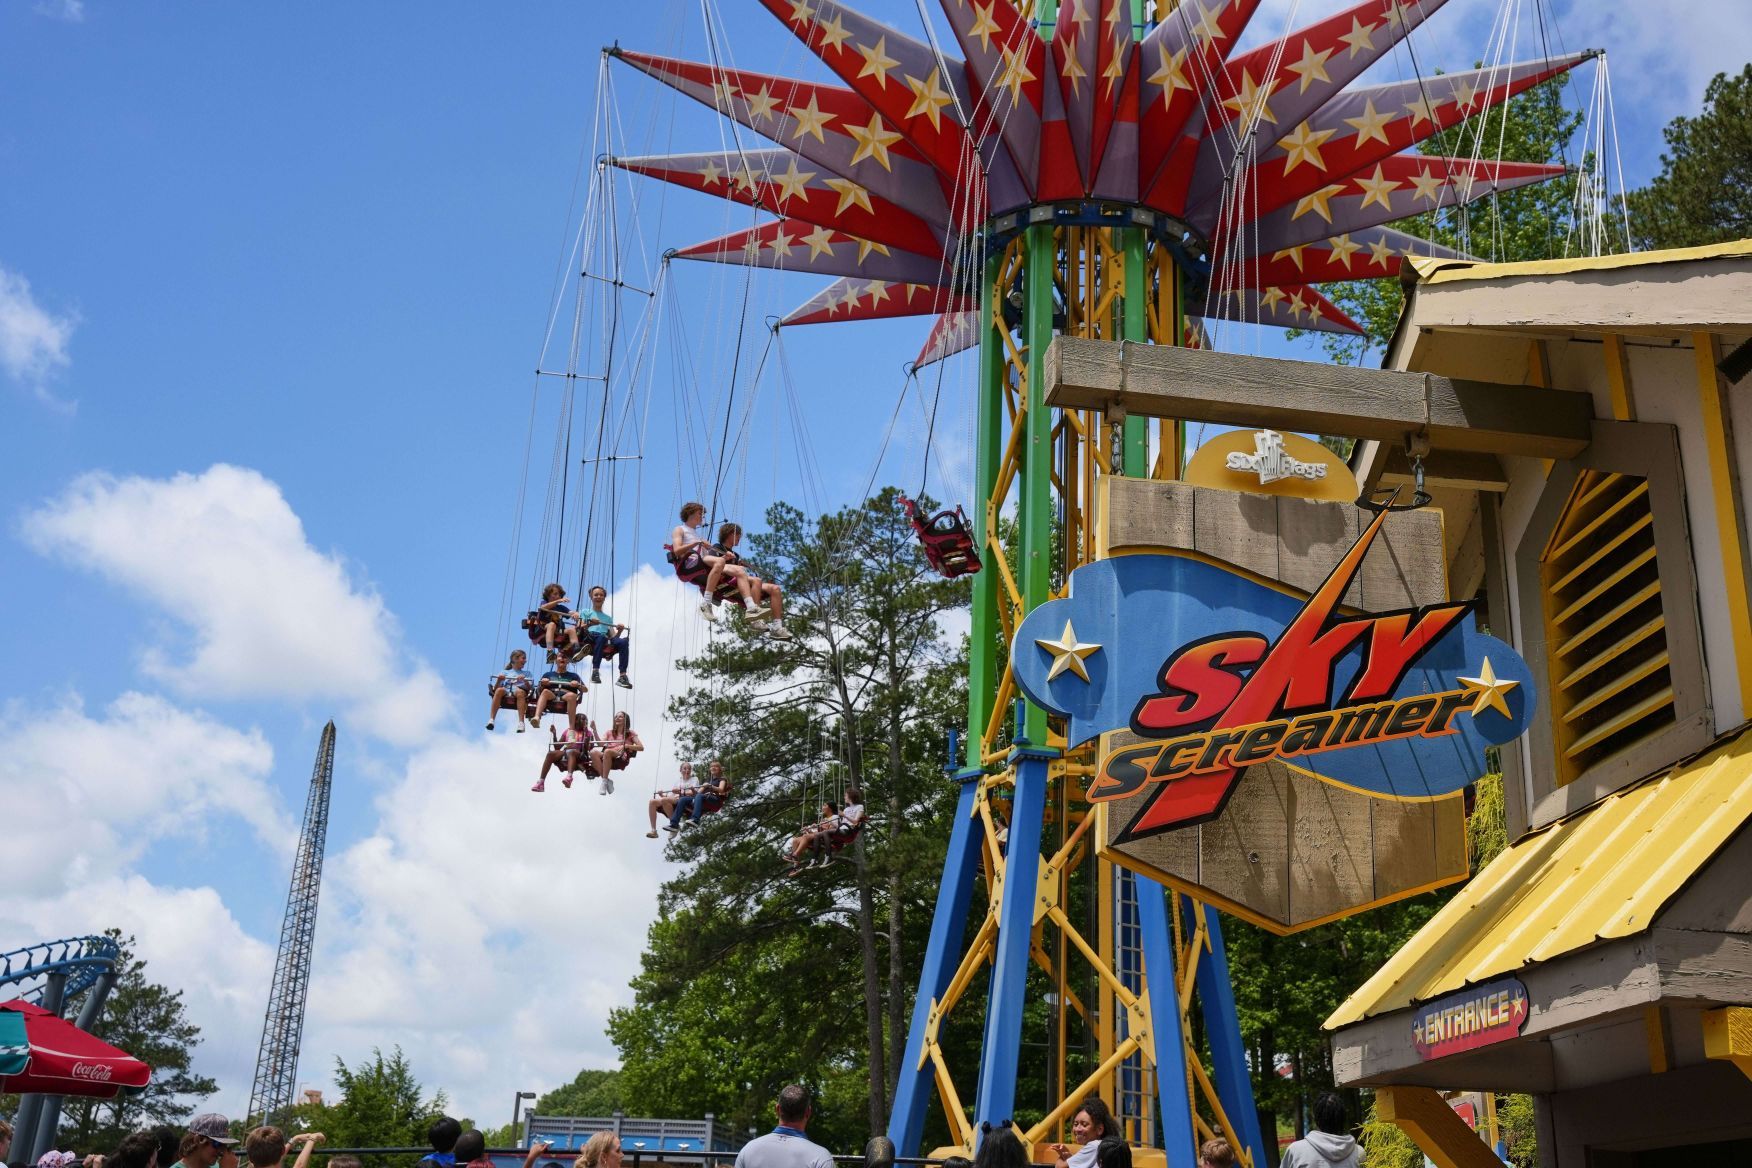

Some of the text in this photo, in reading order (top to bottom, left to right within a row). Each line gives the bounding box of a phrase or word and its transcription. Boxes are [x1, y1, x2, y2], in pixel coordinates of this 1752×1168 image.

[1225, 451, 1328, 479] Six Flags
[1425, 989, 1510, 1044] ENTRANCE
